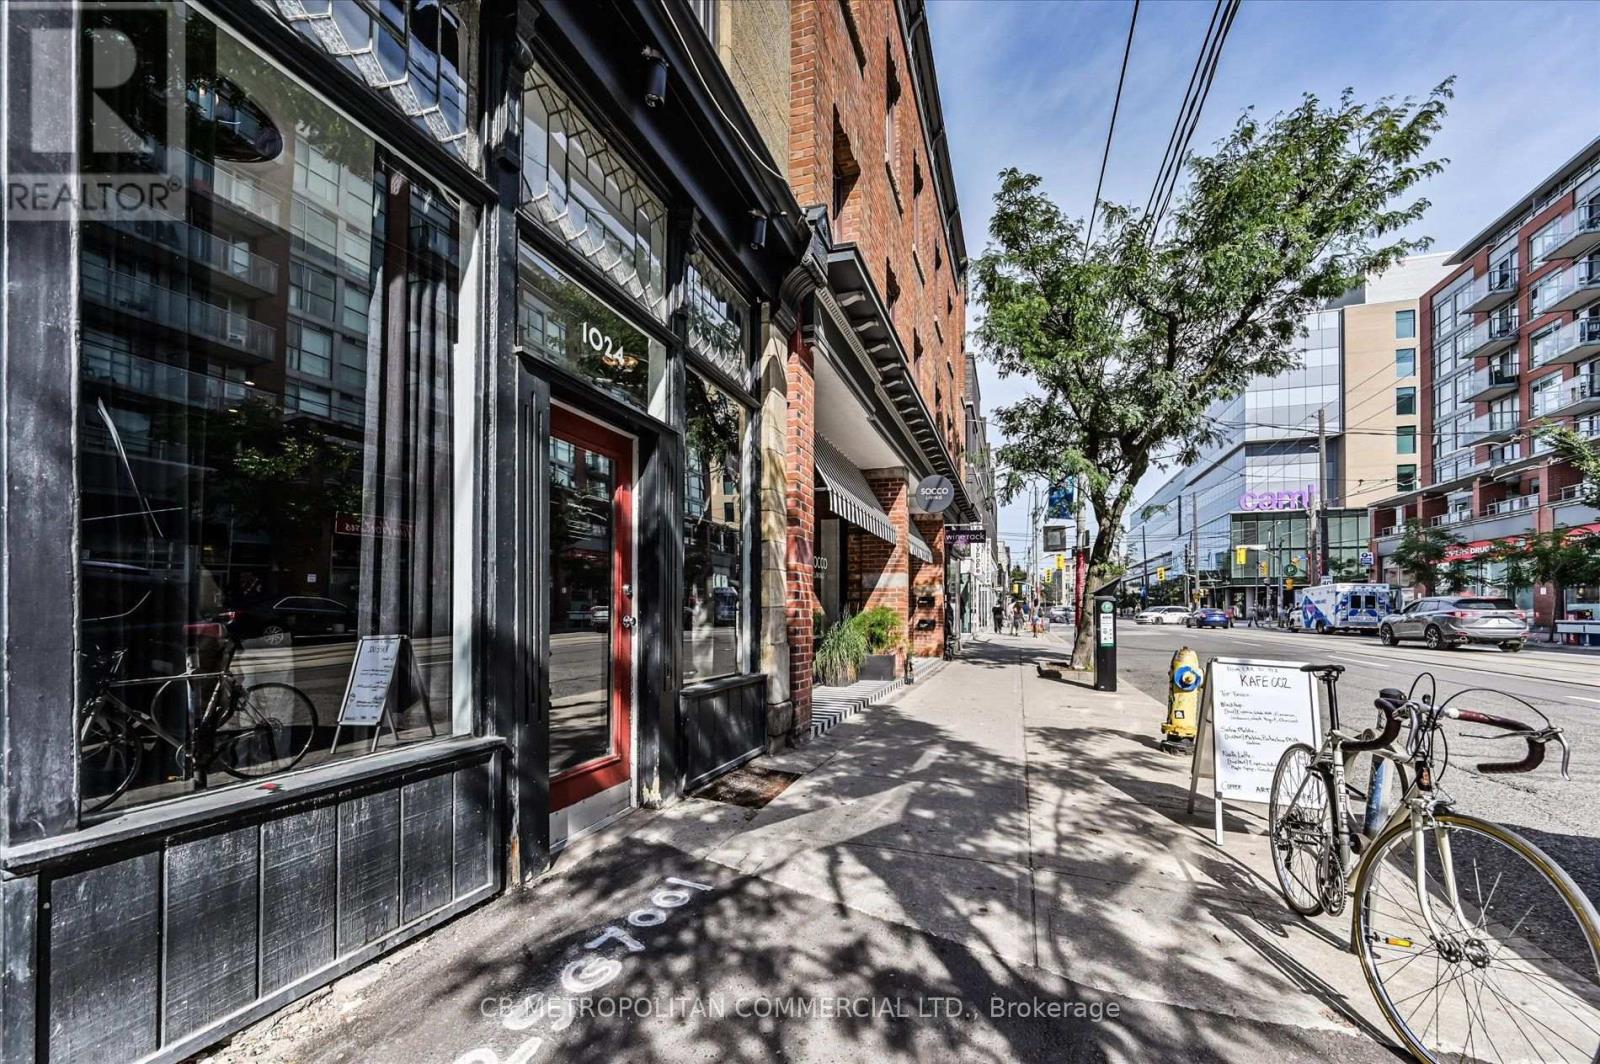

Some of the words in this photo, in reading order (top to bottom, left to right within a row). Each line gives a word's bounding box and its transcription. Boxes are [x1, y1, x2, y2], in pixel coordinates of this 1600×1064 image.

[582, 321, 626, 366] 1024
[920, 487, 949, 496] SOCCO
[1239, 674, 1269, 688] KAFE
